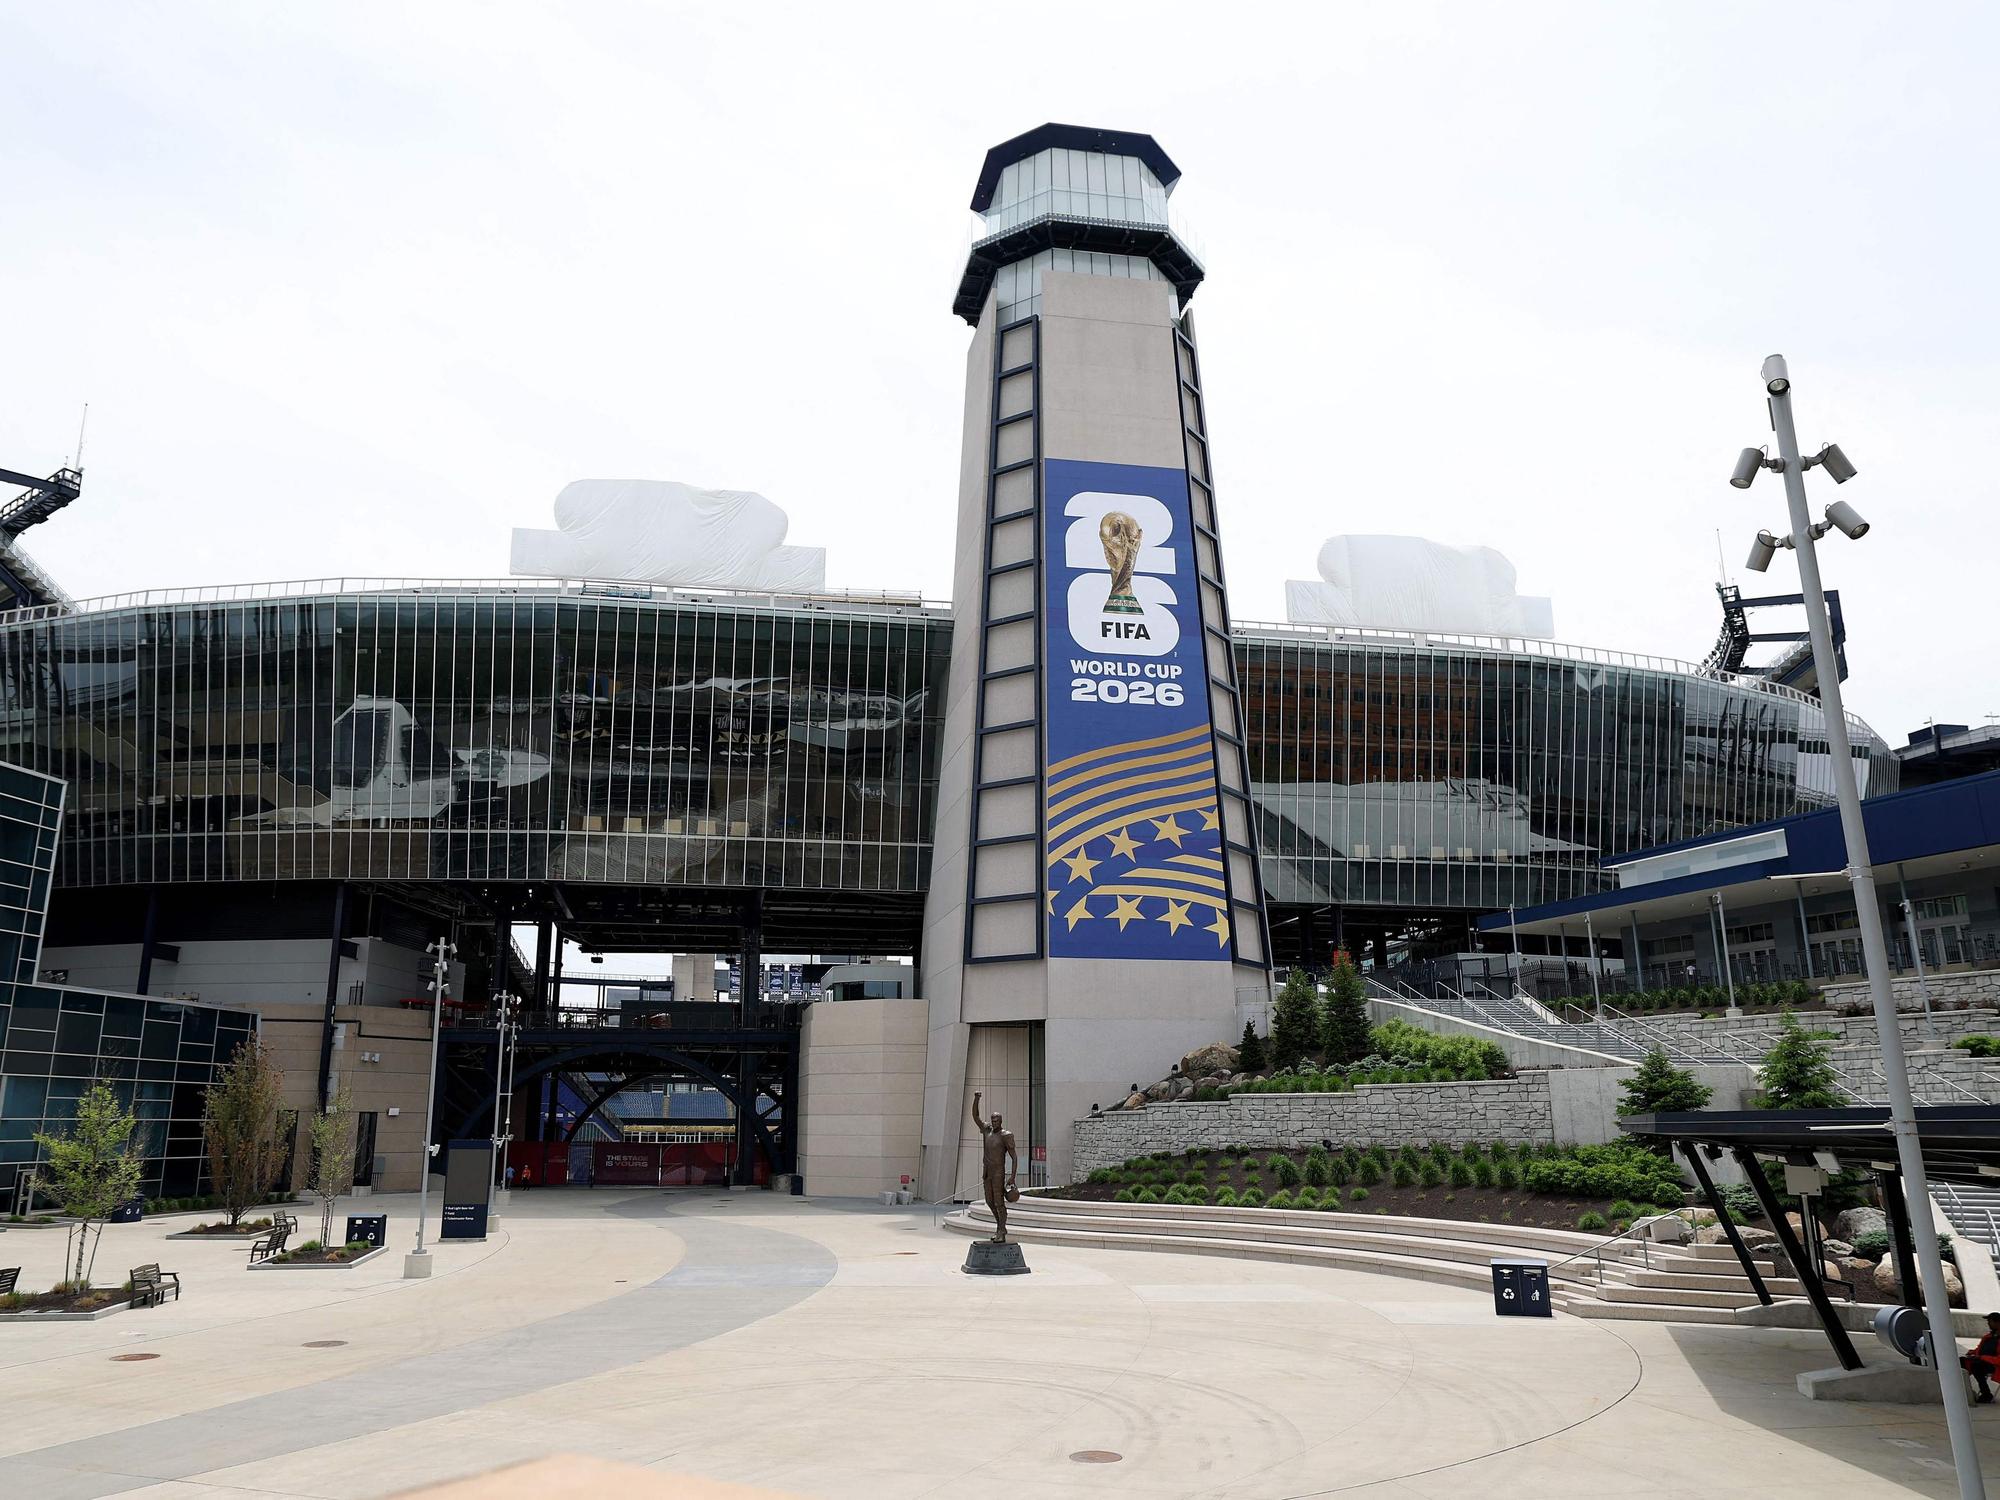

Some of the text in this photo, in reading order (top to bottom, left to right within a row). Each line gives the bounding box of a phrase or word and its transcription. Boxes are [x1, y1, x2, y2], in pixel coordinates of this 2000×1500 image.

[1101, 621, 1151, 640] FIFA
[1070, 659, 1182, 679] WORLD CUP
[1071, 678, 1184, 707] 2026
